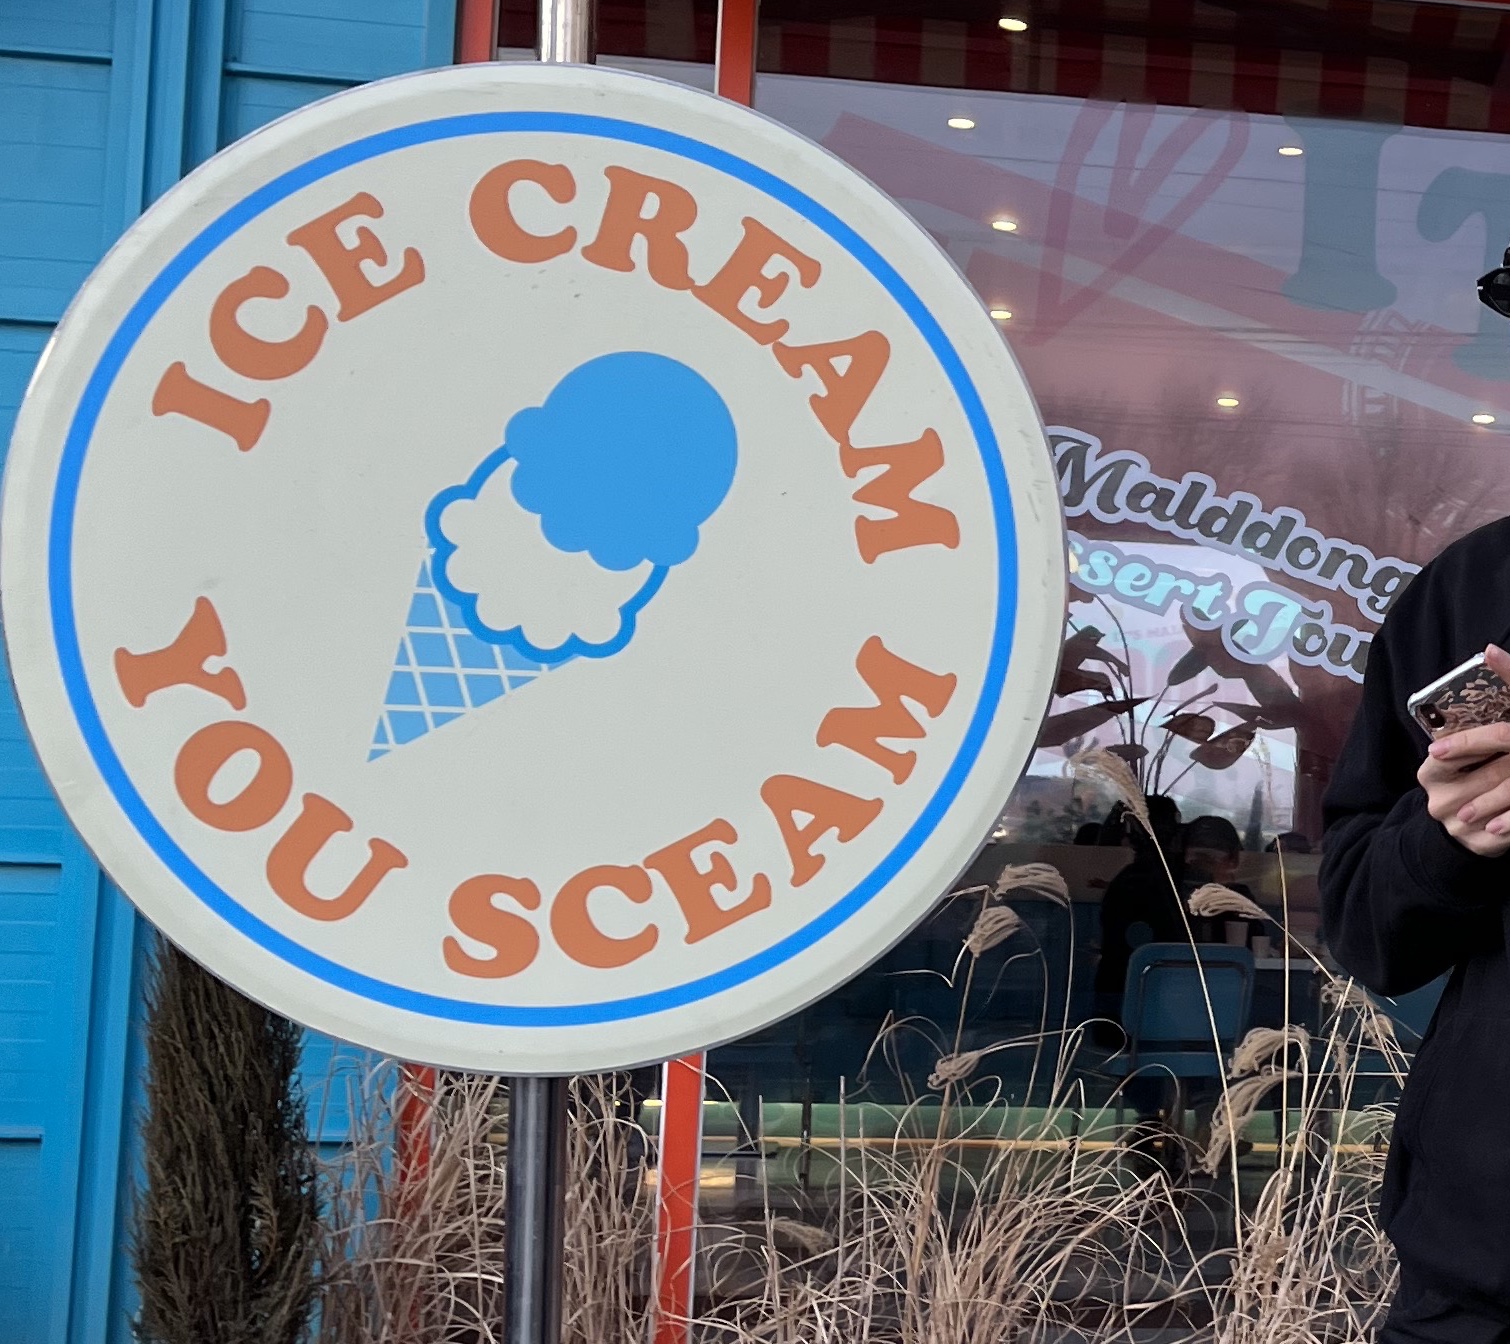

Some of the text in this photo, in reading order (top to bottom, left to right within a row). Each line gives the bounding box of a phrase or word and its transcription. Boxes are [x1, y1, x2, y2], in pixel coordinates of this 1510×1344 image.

[151, 158, 961, 564] ICE CREAM
[113, 595, 958, 979] YOU SCEAM
